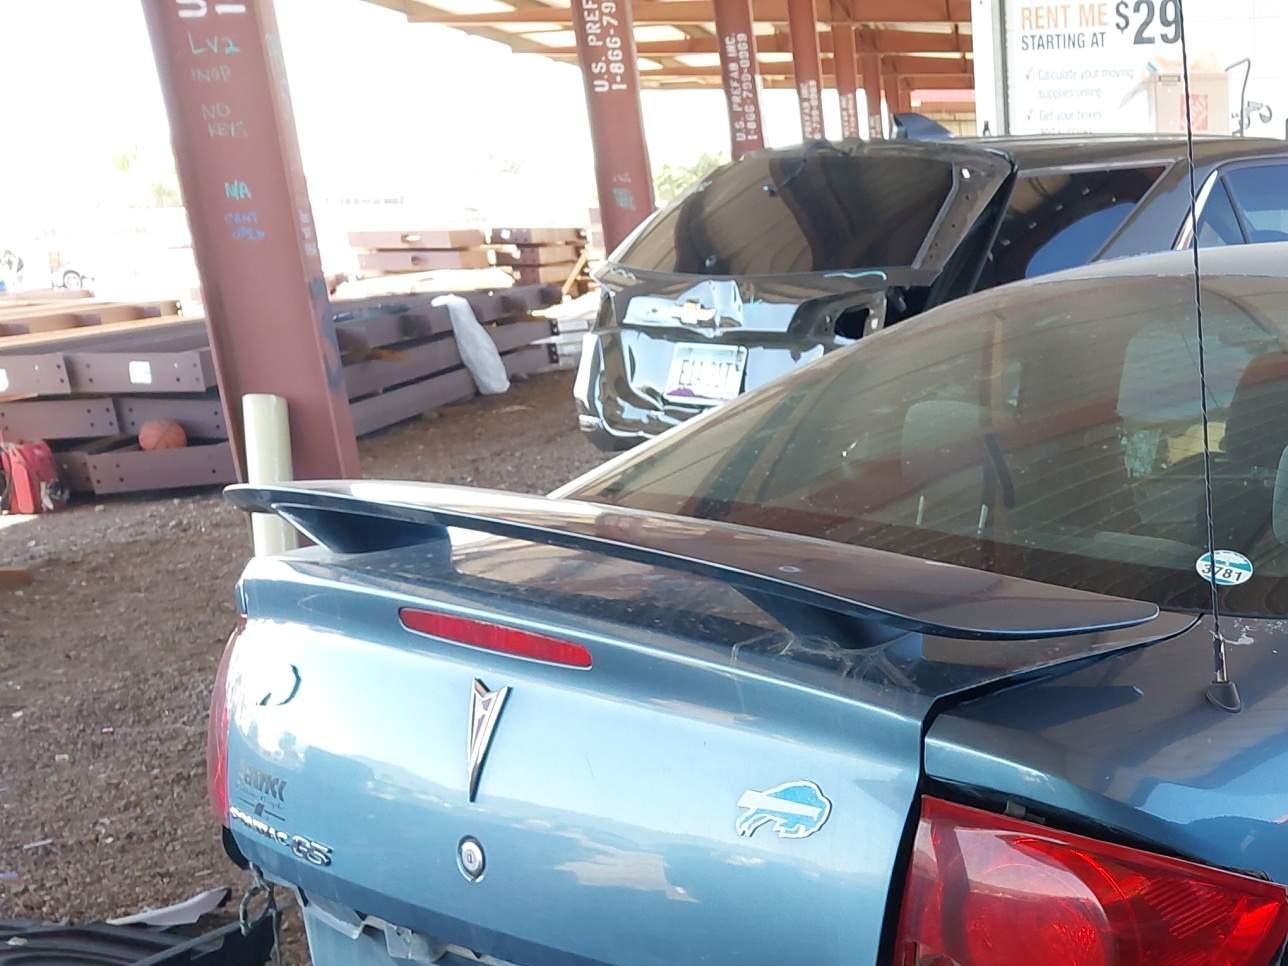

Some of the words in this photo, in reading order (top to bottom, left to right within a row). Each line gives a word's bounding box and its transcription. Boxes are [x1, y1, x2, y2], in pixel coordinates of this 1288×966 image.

[1020, 5, 1070, 31] RENT
[1079, 3, 1108, 28] ME
[1115, 0, 1181, 45] $29
[1021, 33, 1085, 51] STARTING
[1091, 31, 1107, 48] AT
[591, 56, 609, 92] U.S.
[1080, 70, 1100, 82] your
[1102, 68, 1135, 81] moving
[1056, 111, 1074, 123] your
[1202, 563, 1243, 582] 3781
